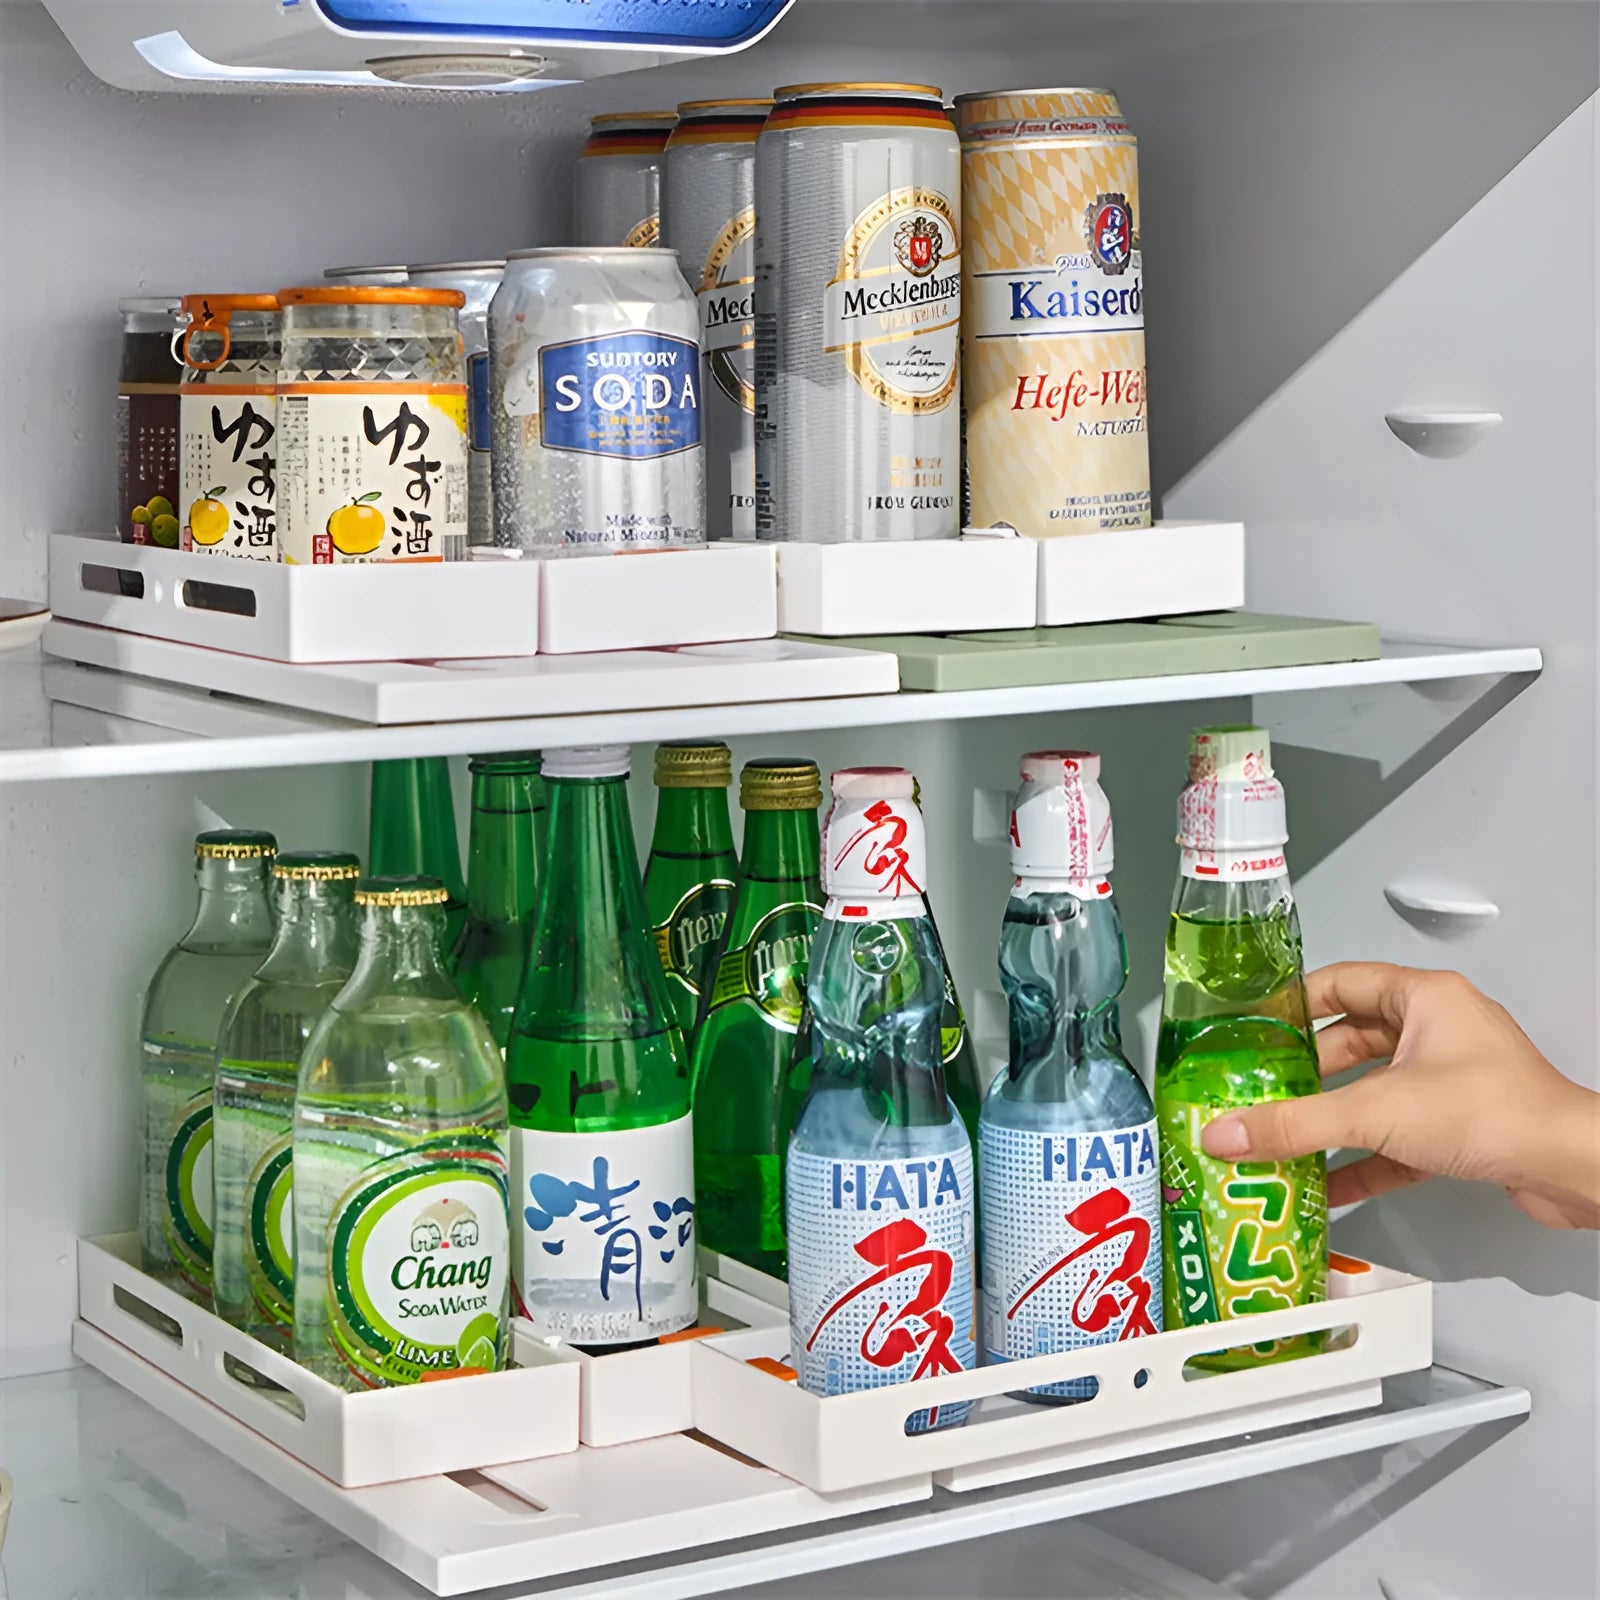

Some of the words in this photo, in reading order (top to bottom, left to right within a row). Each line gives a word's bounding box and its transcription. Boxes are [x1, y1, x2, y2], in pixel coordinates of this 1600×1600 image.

[1009, 276, 1141, 320] Kaiserd
[555, 373, 697, 412] SODA
[363, 401, 442, 554] ゆず酒
[1042, 1129, 1156, 1182] HATA
[832, 1157, 961, 1211] HATA
[390, 1255, 493, 1291] Chang
[1178, 1220, 1210, 1325] メロン
[395, 1339, 454, 1366] LIME
